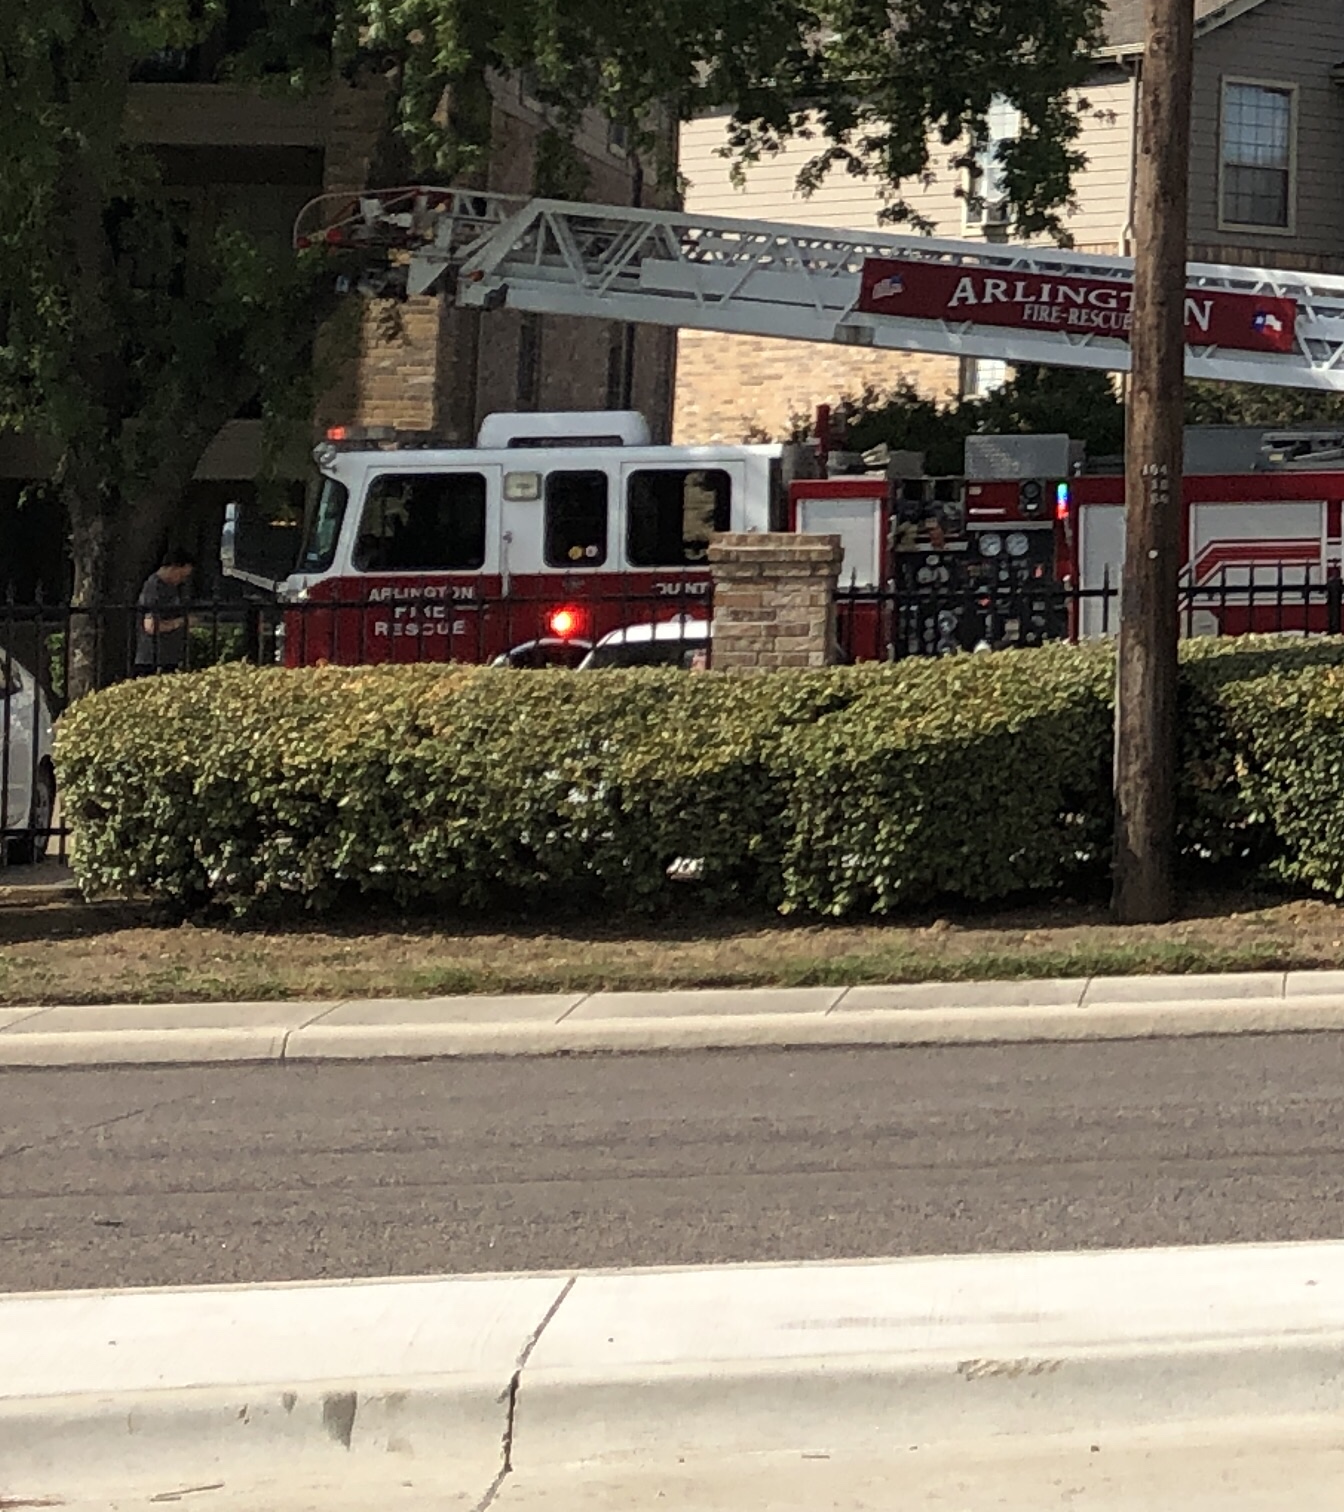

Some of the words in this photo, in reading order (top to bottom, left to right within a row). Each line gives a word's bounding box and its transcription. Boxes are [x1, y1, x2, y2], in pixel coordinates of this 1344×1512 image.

[948, 276, 1213, 332] ARLINGTN
[1022, 303, 1132, 330] FIRE-RESCUE
[654, 582, 709, 595] QUNT
[374, 620, 465, 636] RESCUE
